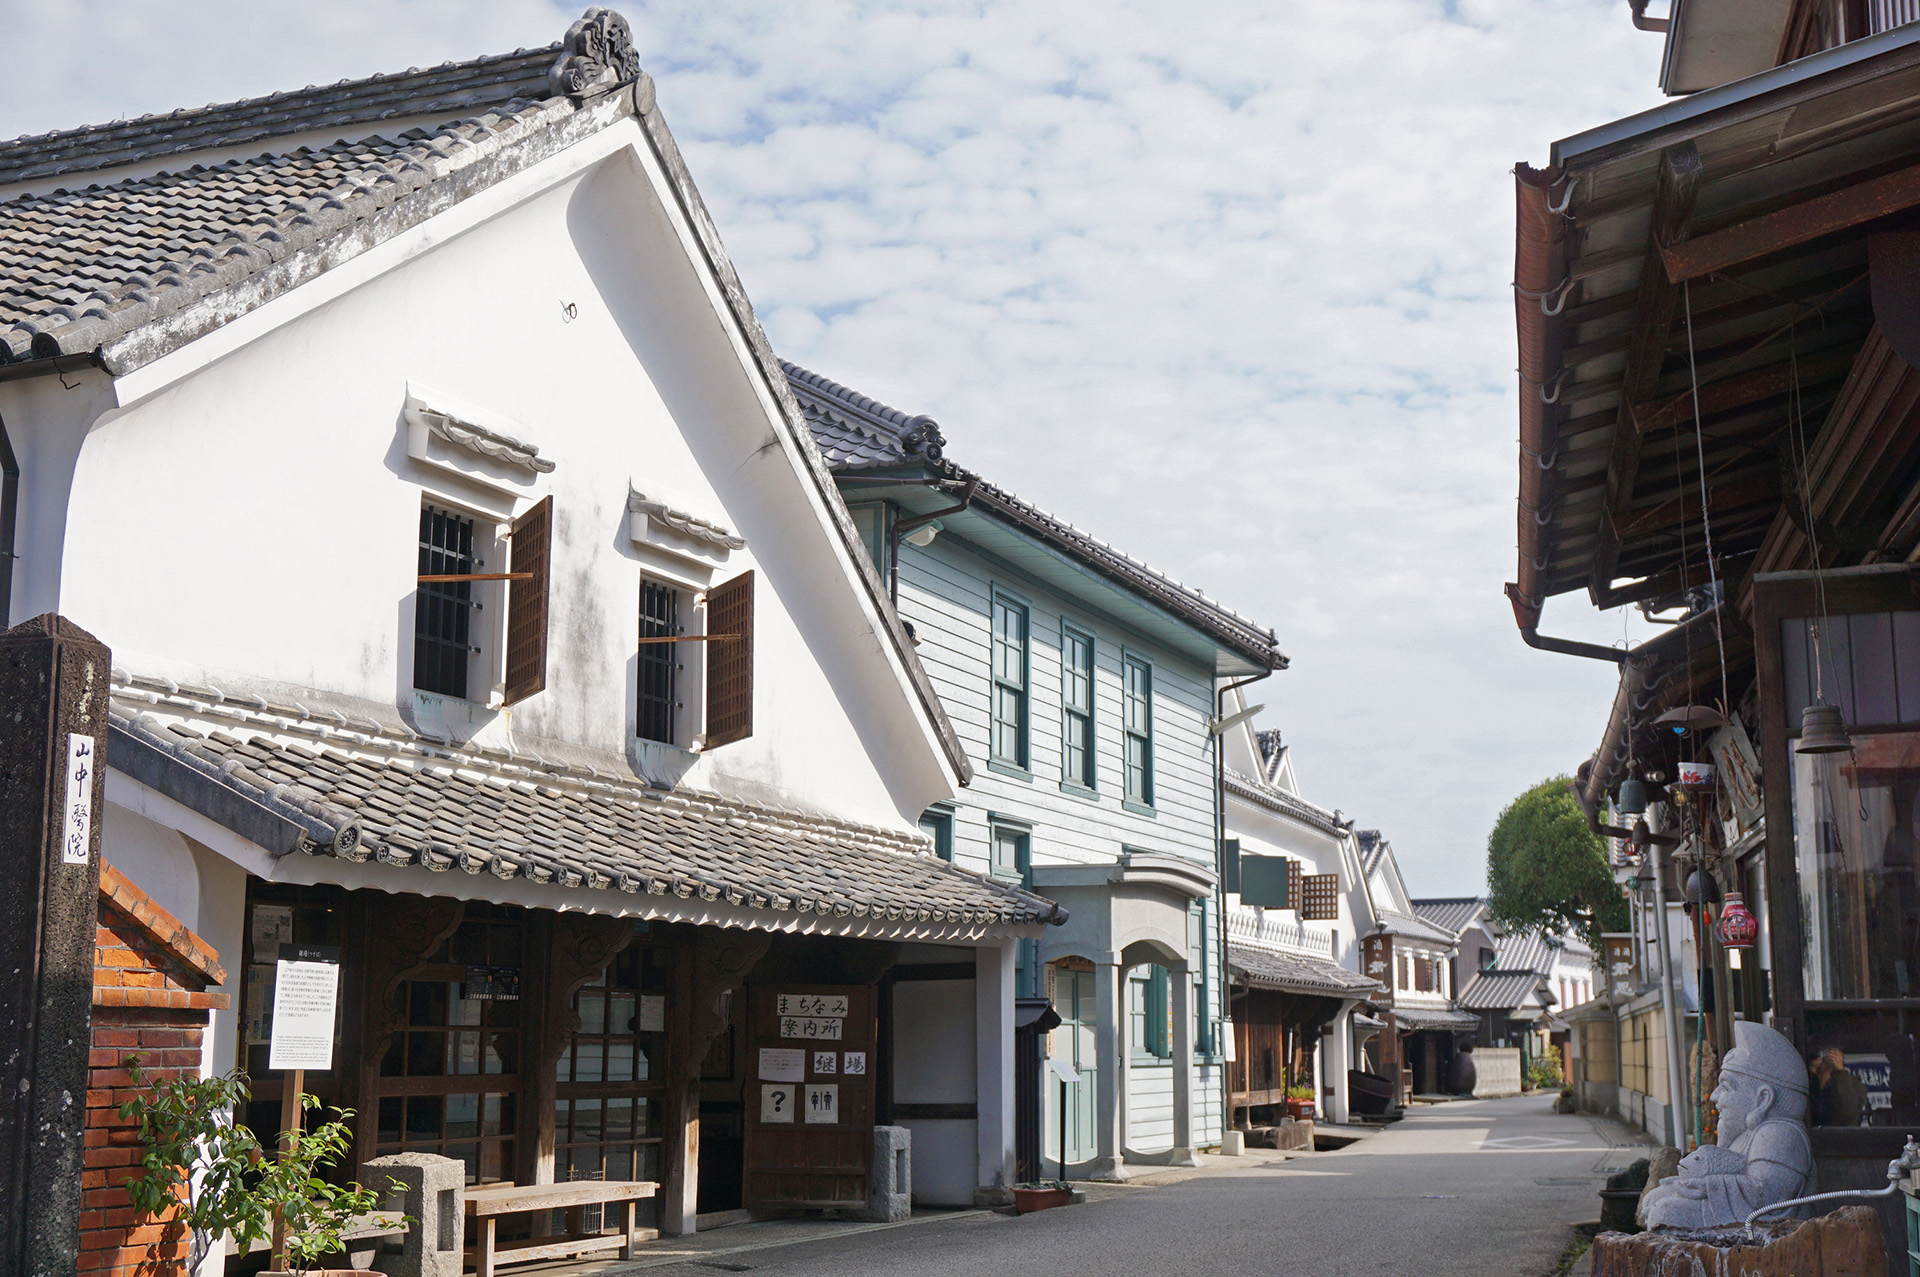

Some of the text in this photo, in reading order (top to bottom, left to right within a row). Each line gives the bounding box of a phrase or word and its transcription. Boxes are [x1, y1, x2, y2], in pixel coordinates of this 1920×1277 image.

[779, 996, 847, 1015] まちなみ
[782, 1018, 840, 1038] 案内所
